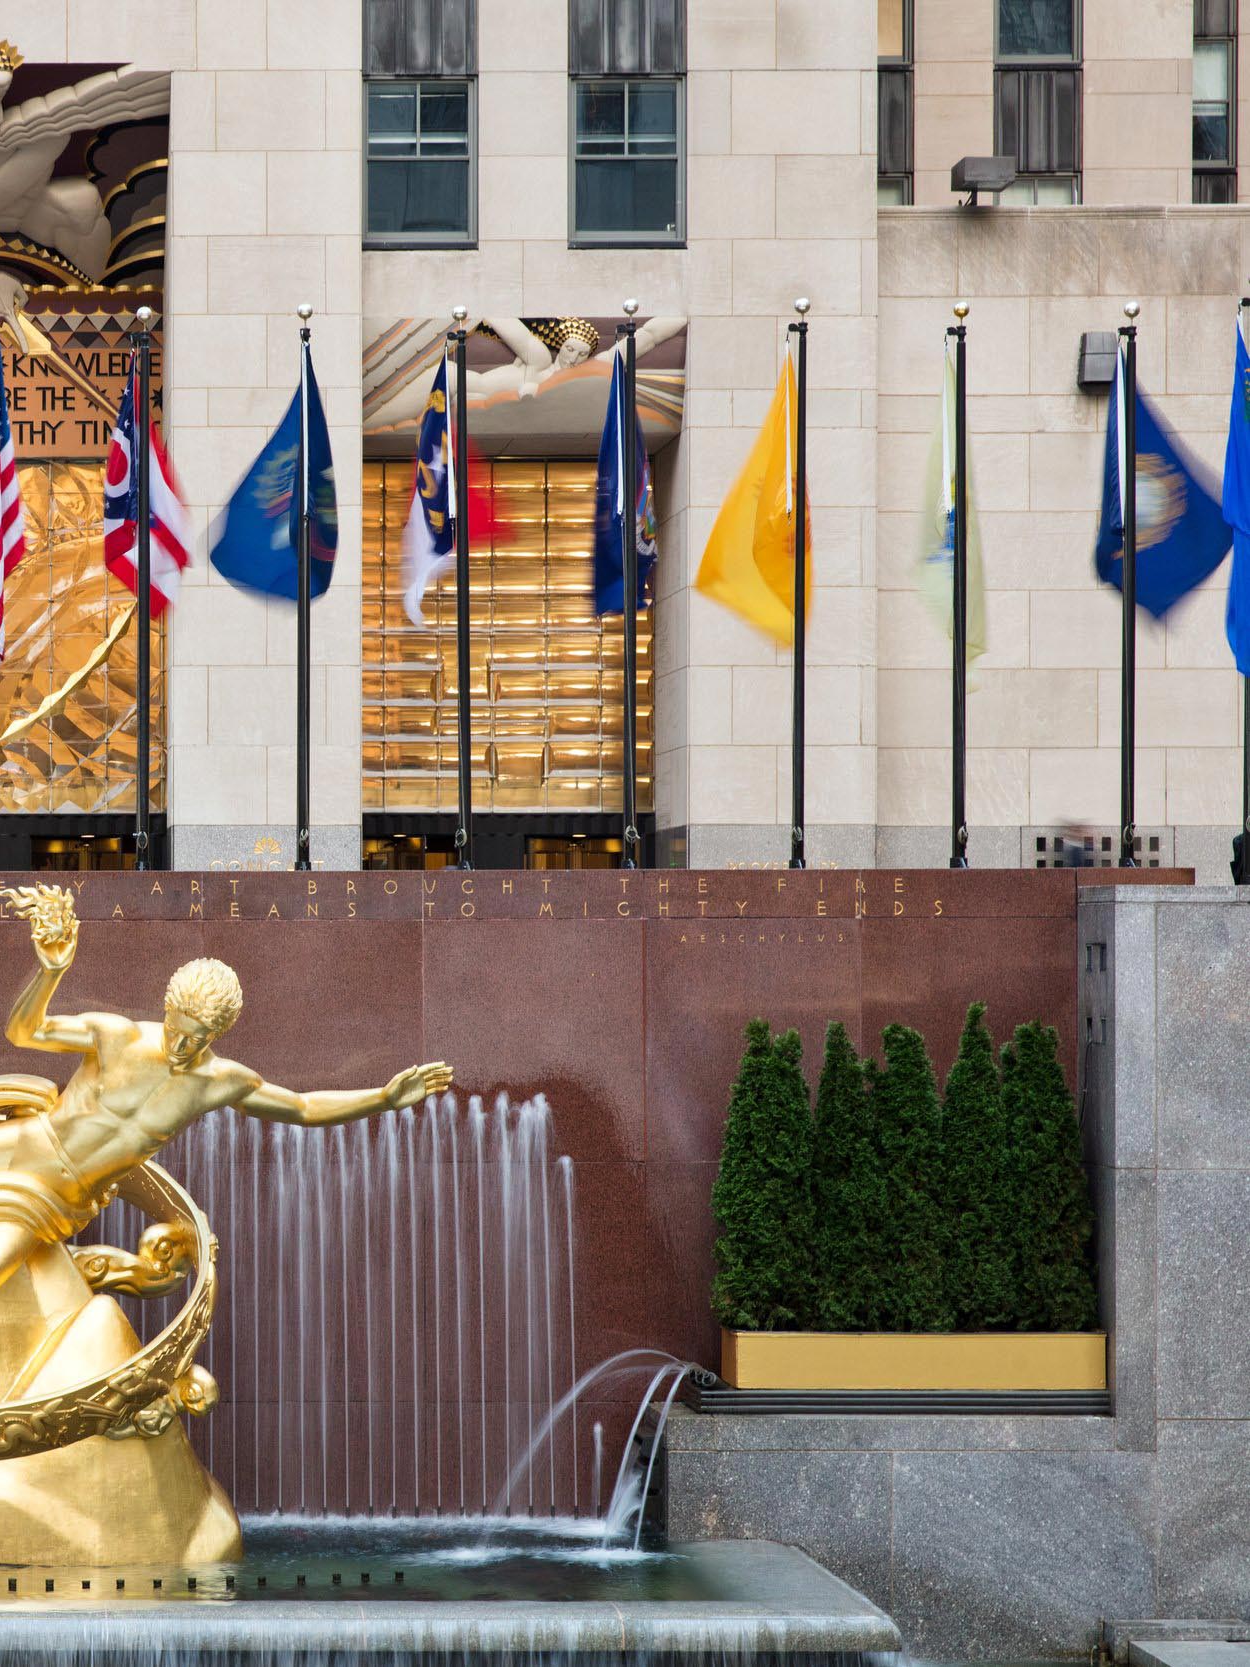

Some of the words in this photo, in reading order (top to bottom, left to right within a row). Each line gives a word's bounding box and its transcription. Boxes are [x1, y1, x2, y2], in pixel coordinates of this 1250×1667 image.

[35, 386, 76, 411] THE
[12, 420, 66, 446] THY
[209, 860, 325, 871] COMCAT
[150, 880, 240, 895] ART
[307, 879, 552, 895] BROUGHT
[619, 878, 708, 894] THE
[777, 877, 905, 893] FIRE
[111, 903, 124, 918] A
[189, 903, 356, 918] MEANS
[423, 902, 475, 918] TO
[539, 901, 748, 917] MIGHTY
[817, 900, 943, 916] ENDS
[680, 934, 845, 943] AESCHYLUS
